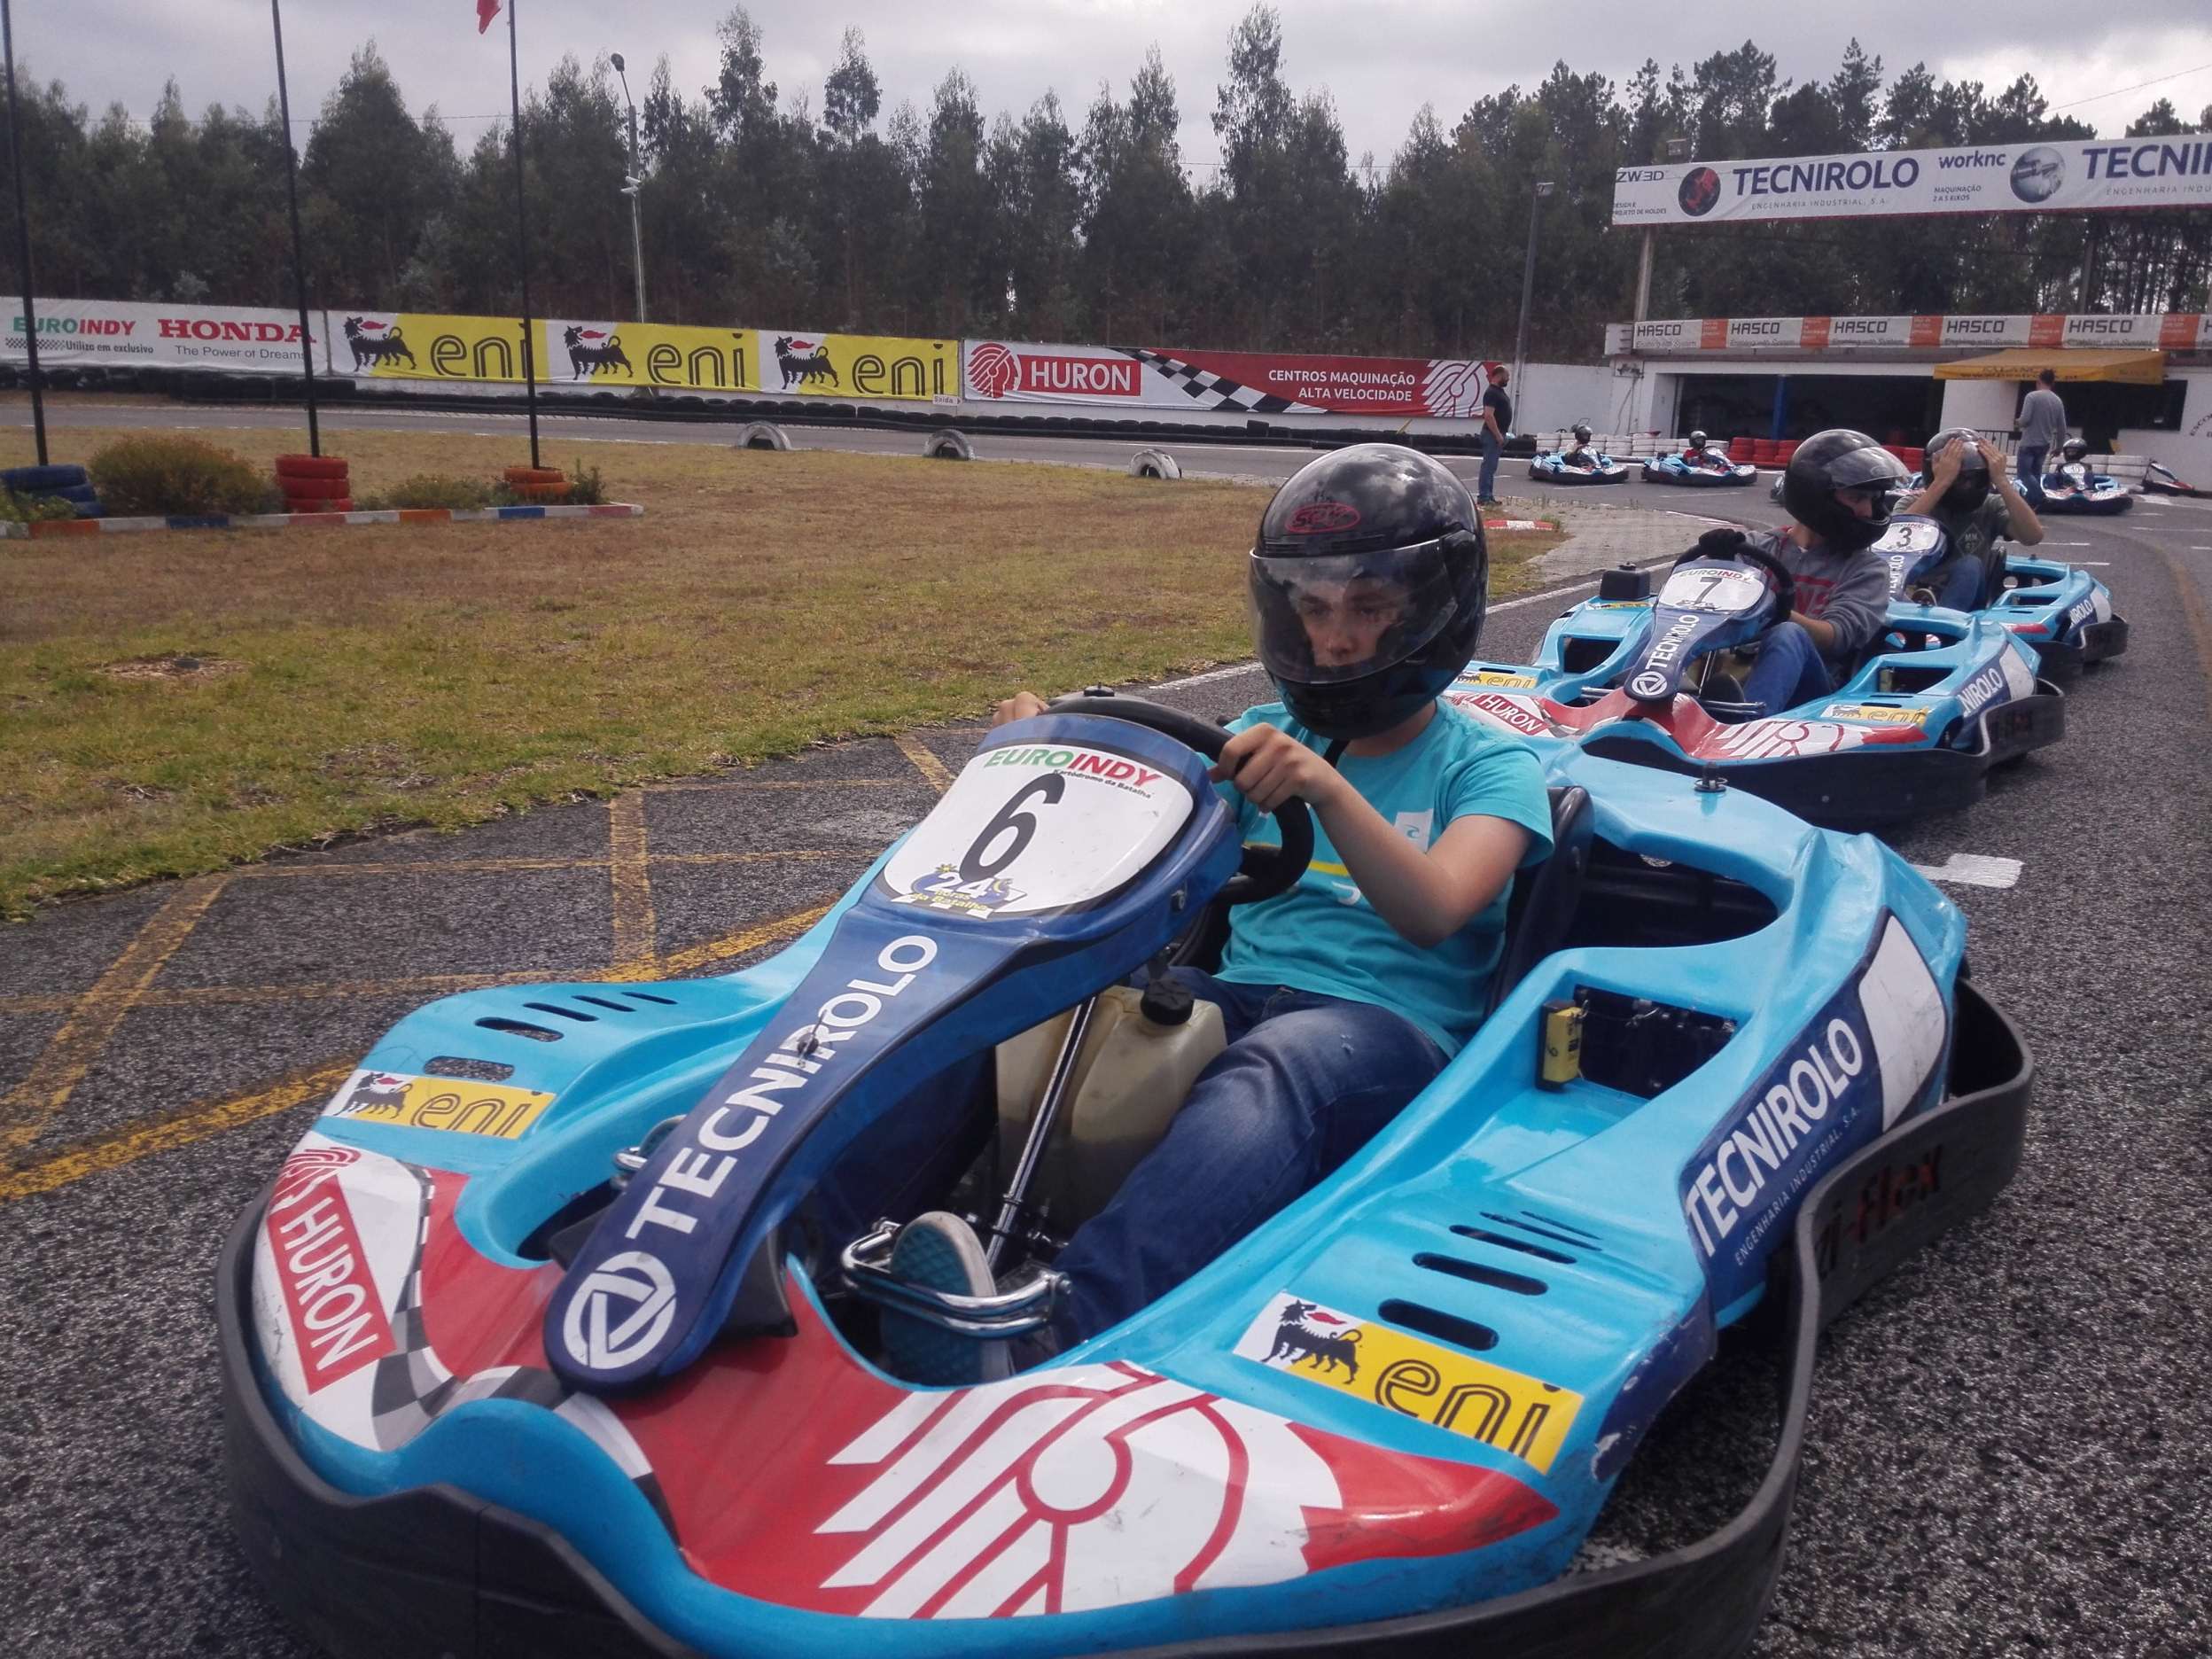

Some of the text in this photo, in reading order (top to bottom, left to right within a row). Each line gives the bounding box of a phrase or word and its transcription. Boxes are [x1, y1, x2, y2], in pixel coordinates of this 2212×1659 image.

[1938, 151, 2006, 169] worknc
[1733, 158, 1920, 196] TECNIROLO
[158, 319, 316, 343] HONDA
[1637, 323, 1682, 337] HASCO
[1731, 322, 1780, 335] HASCO
[1834, 321, 1888, 334] HASCO
[1946, 320, 2005, 333] HASCO
[2069, 319, 2133, 333] HASCO
[66, 340, 95, 352] Utiliza
[113, 343, 154, 354] exclusivo
[175, 345, 199, 356] The
[203, 347, 240, 358] Power
[245, 348, 256, 359] of
[647, 332, 745, 388] eni
[852, 343, 945, 396] eni
[1030, 361, 1133, 392] HURON
[1268, 370, 1415, 387] CENTROS MAQUINAÇÃO
[1298, 387, 1412, 401] ALTA VELOCIDADE
[1897, 527, 1912, 549] 3
[1694, 576, 1723, 604] 7
[1479, 695, 1543, 732] HURON
[984, 748, 1162, 787] EUROINDY
[1105, 777, 1116, 787] da
[960, 773, 1066, 883] 6
[924, 871, 995, 899] 24
[625, 935, 939, 1241] TECNIROLO
[410, 1090, 542, 1137] eni
[1686, 1018, 1863, 1258] TECNIROLO
[1734, 1191, 1791, 1266] ENGENHARIA
[280, 1196, 379, 1371] HURON
[1375, 1359, 1562, 1459] eni
